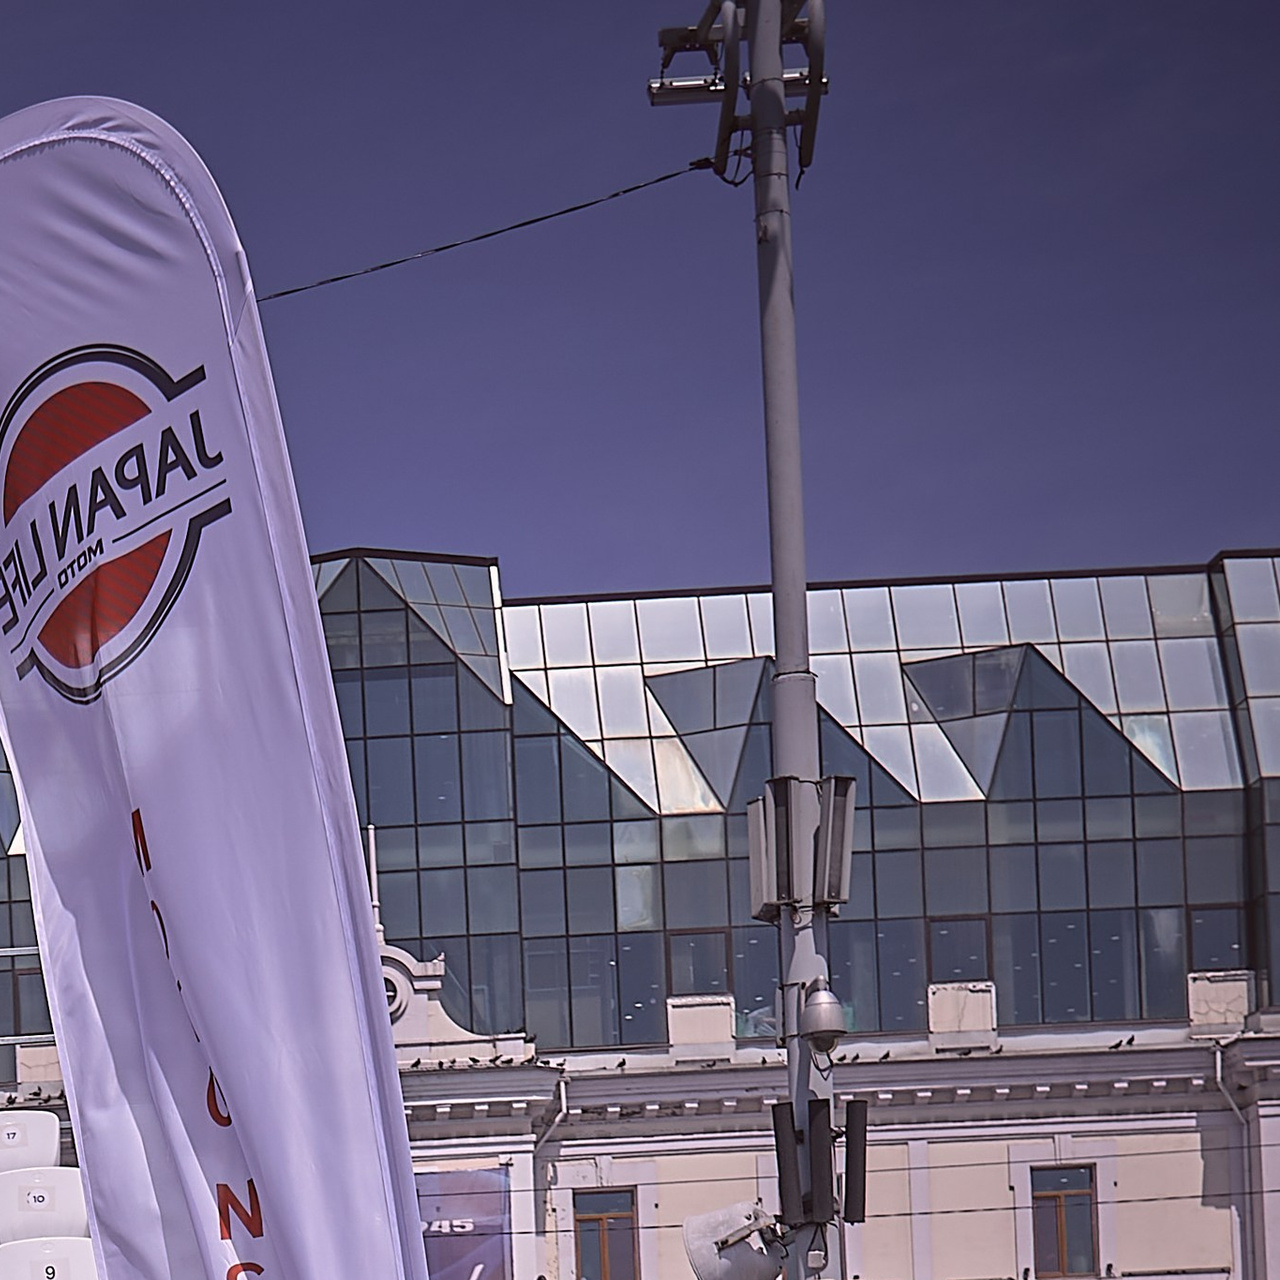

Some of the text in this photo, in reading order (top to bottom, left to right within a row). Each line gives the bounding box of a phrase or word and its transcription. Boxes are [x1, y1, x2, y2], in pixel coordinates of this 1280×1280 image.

[6, 1132, 17, 1140] 17
[33, 1194, 45, 1203] 10
[45, 1265, 56, 1280] 9
